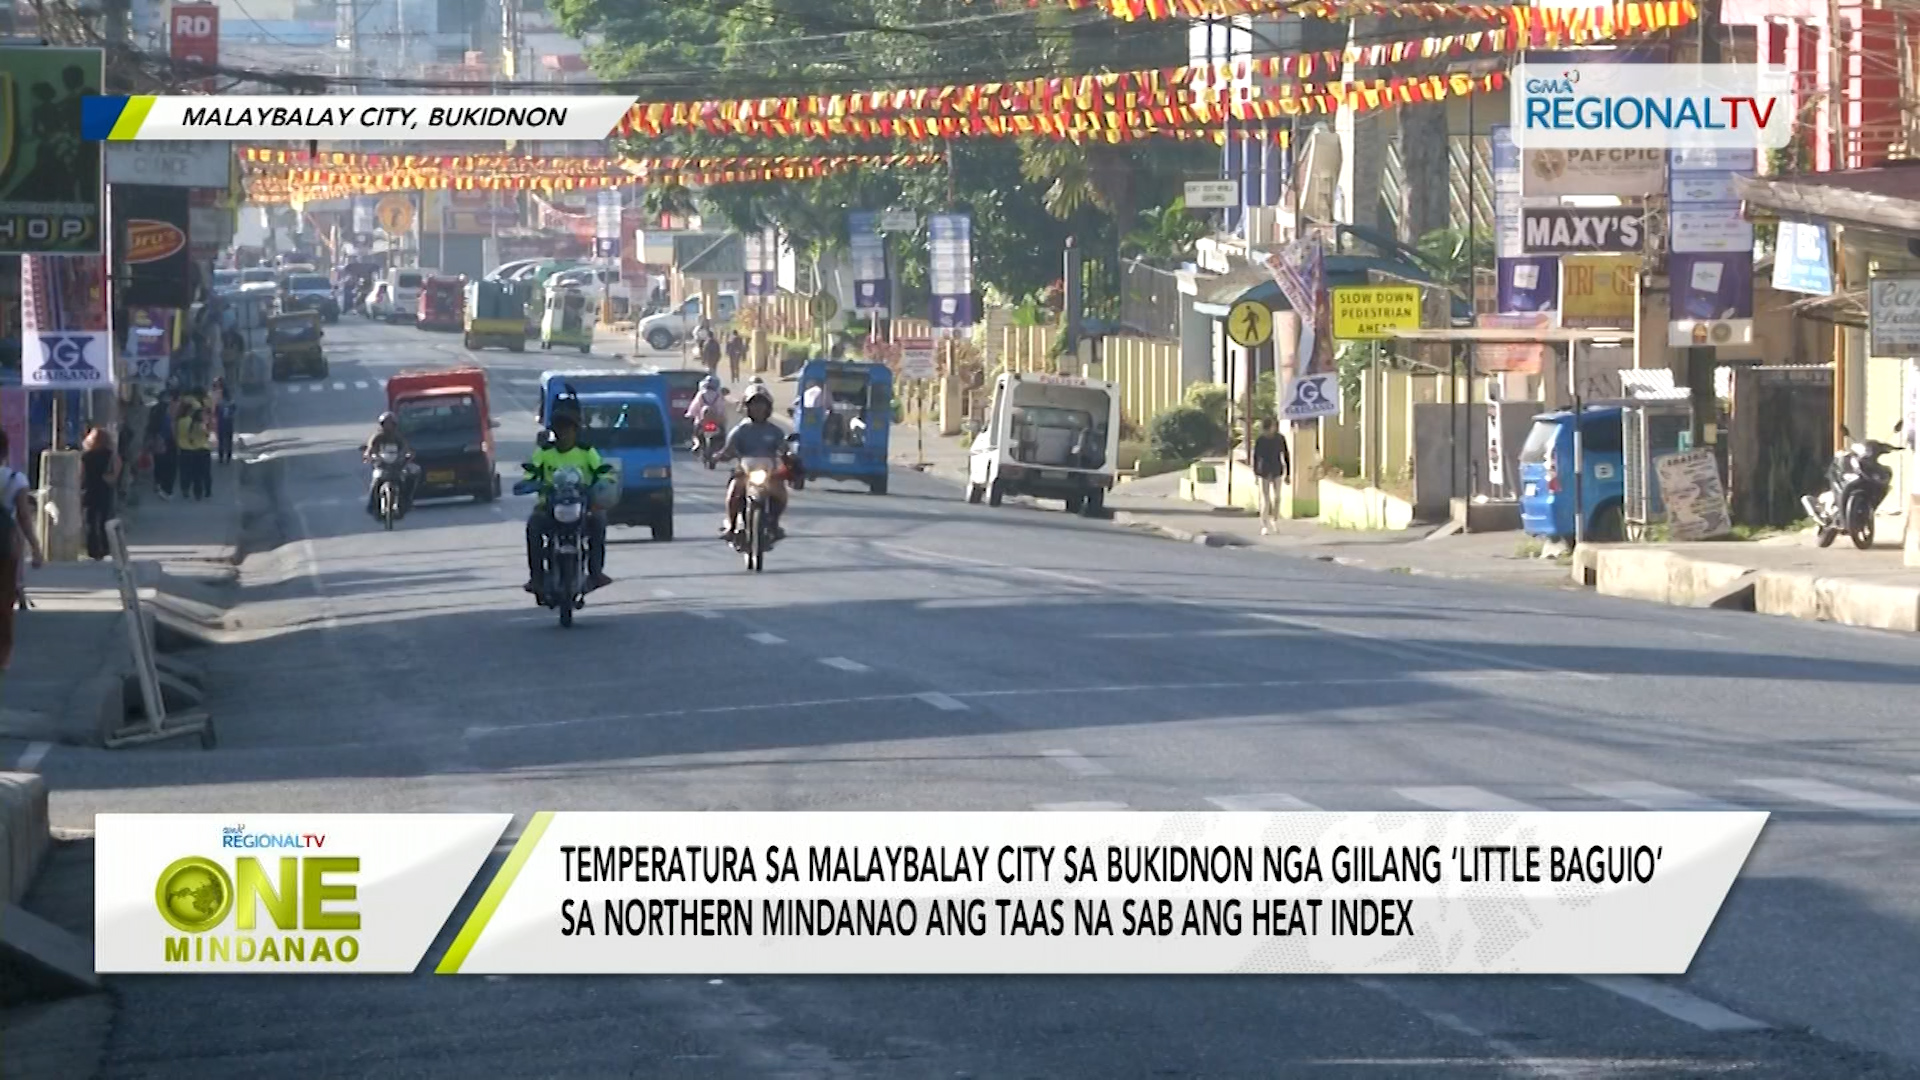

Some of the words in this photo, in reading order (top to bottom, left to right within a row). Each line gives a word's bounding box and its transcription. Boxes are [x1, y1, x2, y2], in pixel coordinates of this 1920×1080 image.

[1526, 216, 1638, 247] MAXY'S
[1340, 293, 1372, 304] SLOW
[1376, 293, 1414, 304] DOWN
[1341, 307, 1412, 319] PEDESTRIAN
